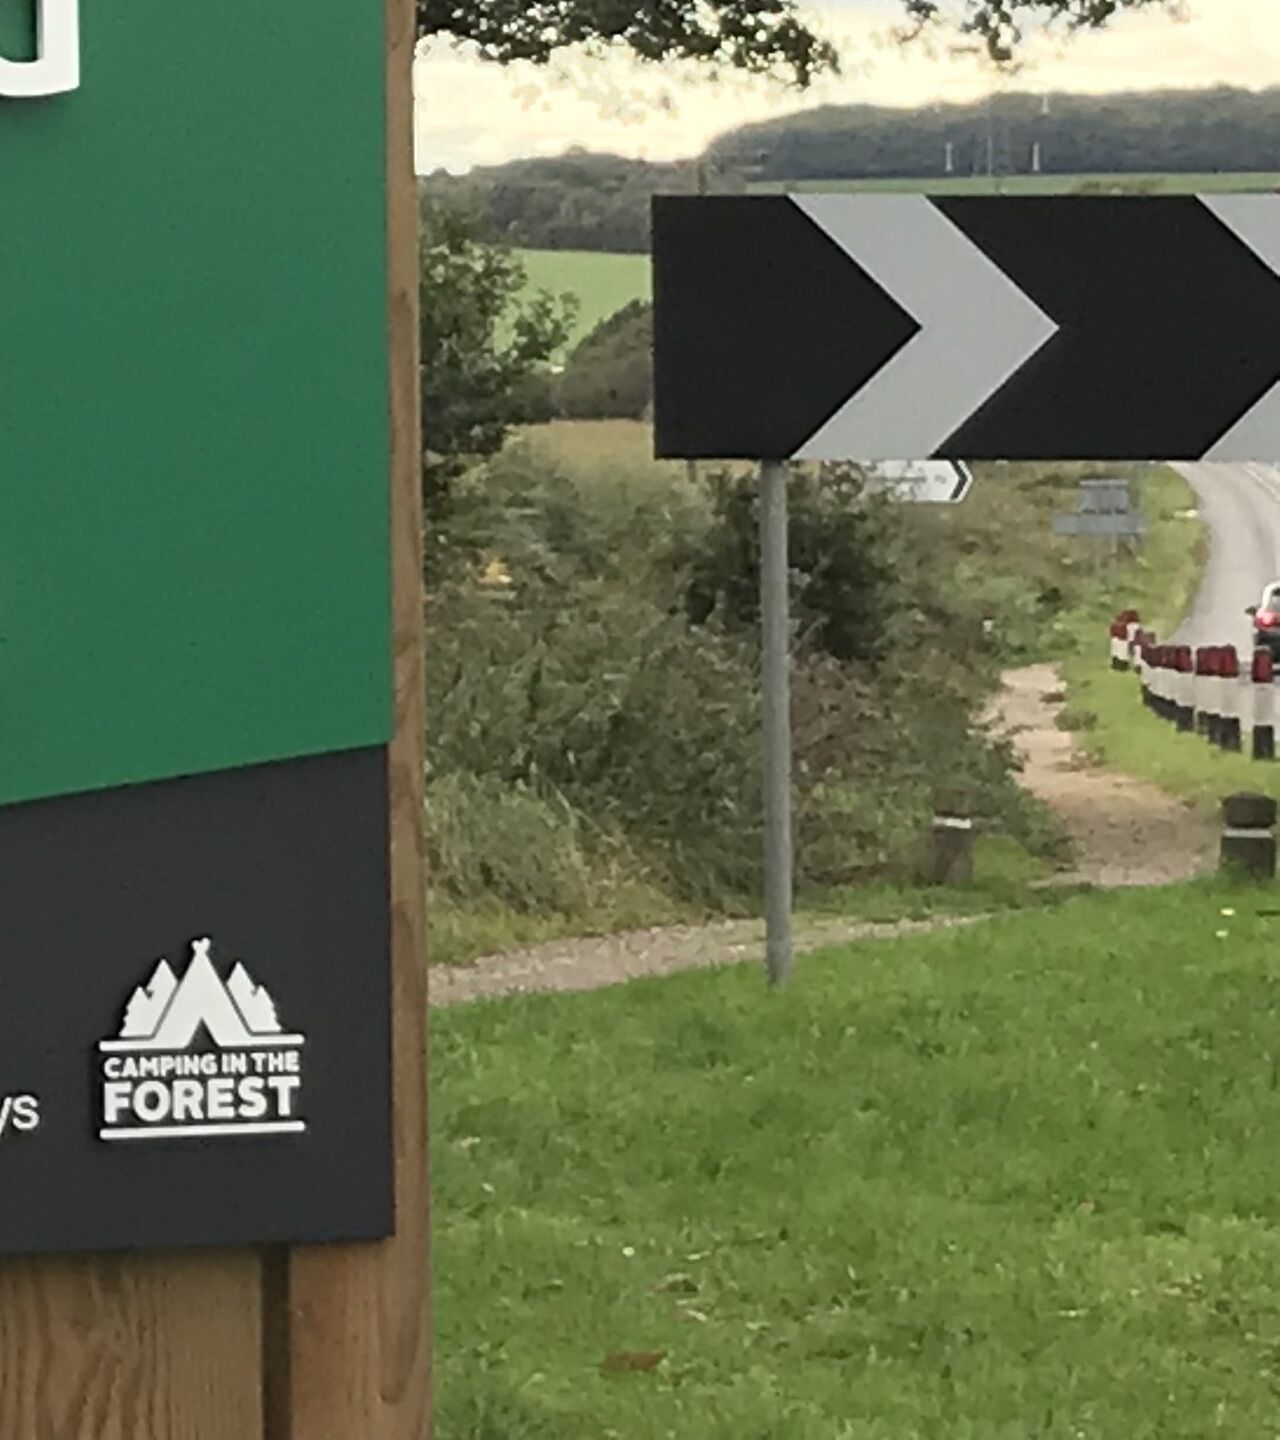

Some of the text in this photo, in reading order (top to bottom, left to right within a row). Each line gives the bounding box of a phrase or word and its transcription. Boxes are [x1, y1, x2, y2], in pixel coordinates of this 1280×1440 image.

[104, 1050, 300, 1079] CAMPING IN THE
[104, 1075, 301, 1123] FOREST
